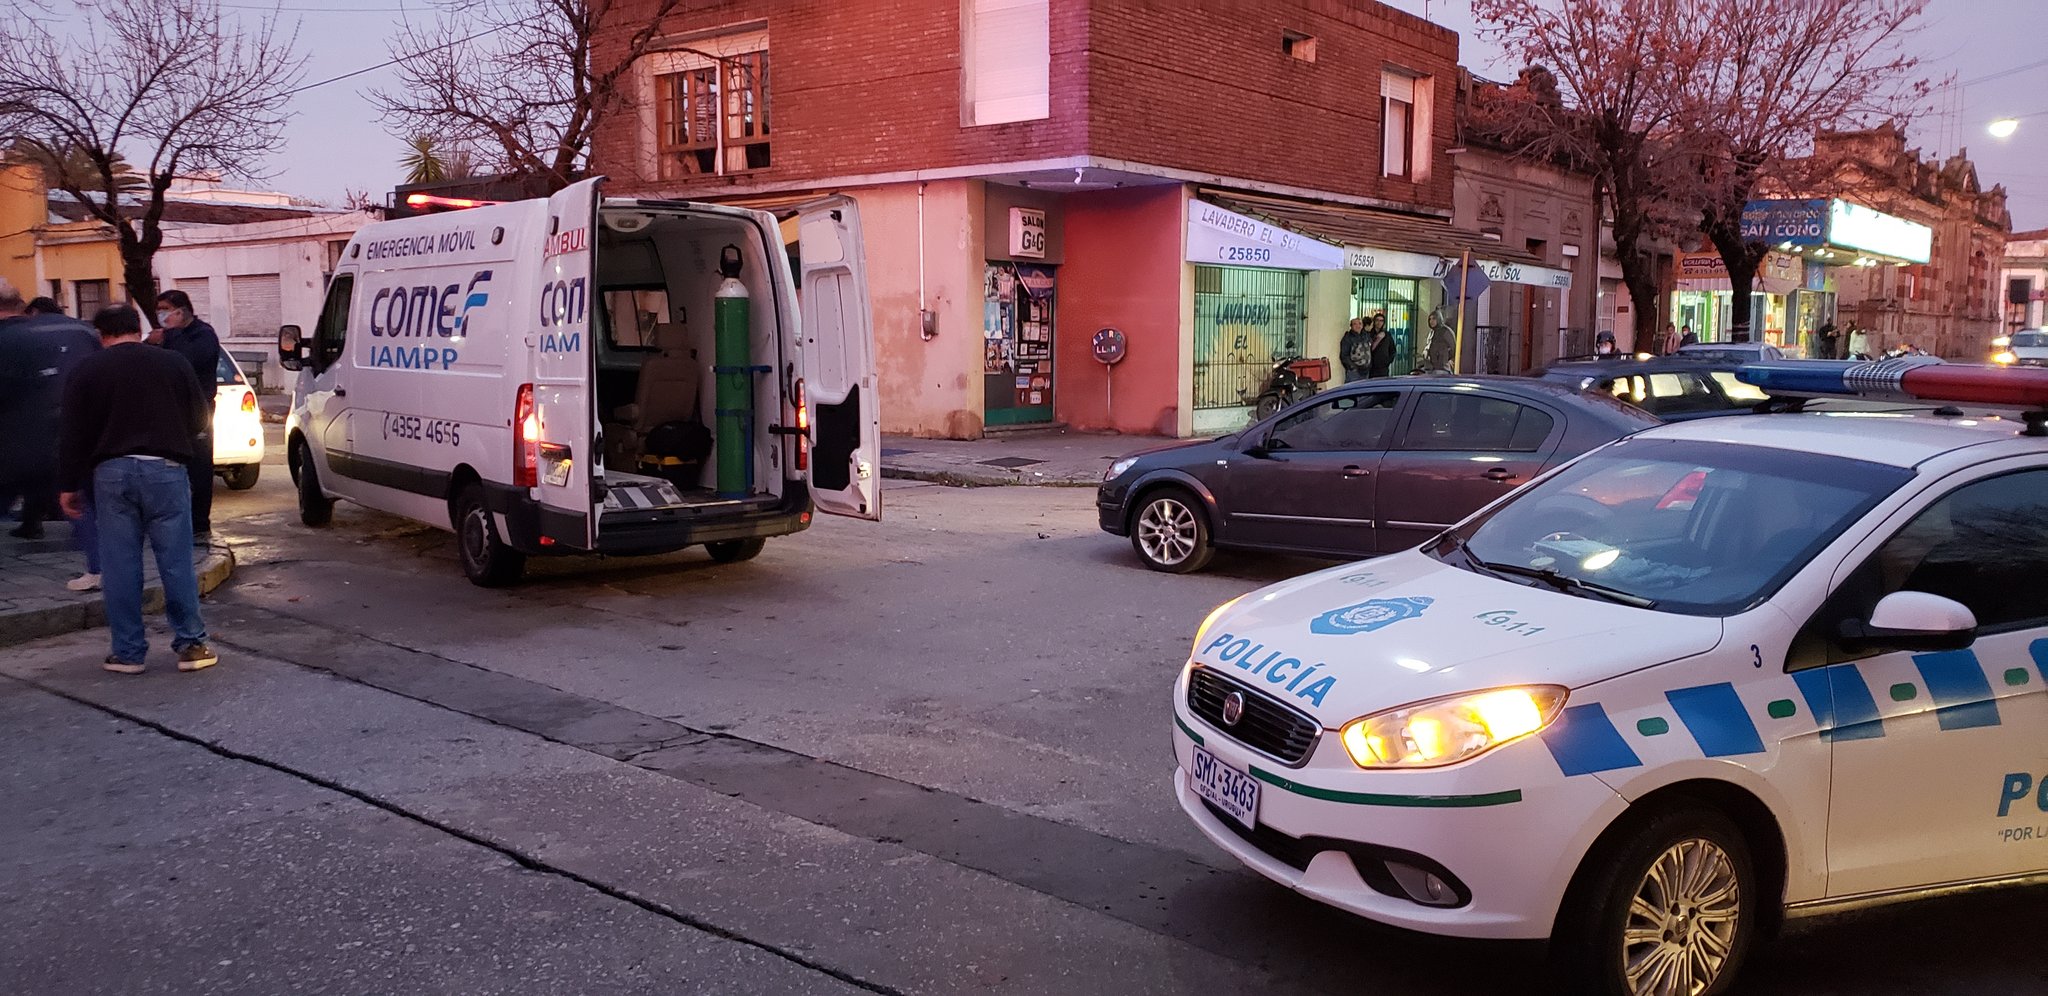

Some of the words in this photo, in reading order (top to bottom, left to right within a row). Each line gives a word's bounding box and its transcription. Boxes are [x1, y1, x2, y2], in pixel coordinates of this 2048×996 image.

[1021, 216, 1044, 229] SALON
[1201, 208, 1256, 237] LAVADERO
[1260, 227, 1273, 244] EL
[1739, 224, 1770, 237] SAN
[1775, 223, 1820, 237] CONO
[366, 235, 434, 260] EMERGENCIA
[438, 225, 476, 253] MÓVIL
[1021, 230, 1044, 251] G&G
[1228, 247, 1270, 262] 25850
[1353, 254, 1375, 268] 25850
[1489, 265, 1500, 278] EL
[1503, 267, 1521, 281] SOL
[1215, 303, 1270, 326] LAVADERO
[1234, 335, 1248, 350] EL
[370, 345, 458, 370] IAMPP
[392, 415, 421, 440] 4352
[425, 420, 460, 447] 4656
[1751, 644, 1762, 668] 3
[1202, 633, 1337, 708] POLICÍA
